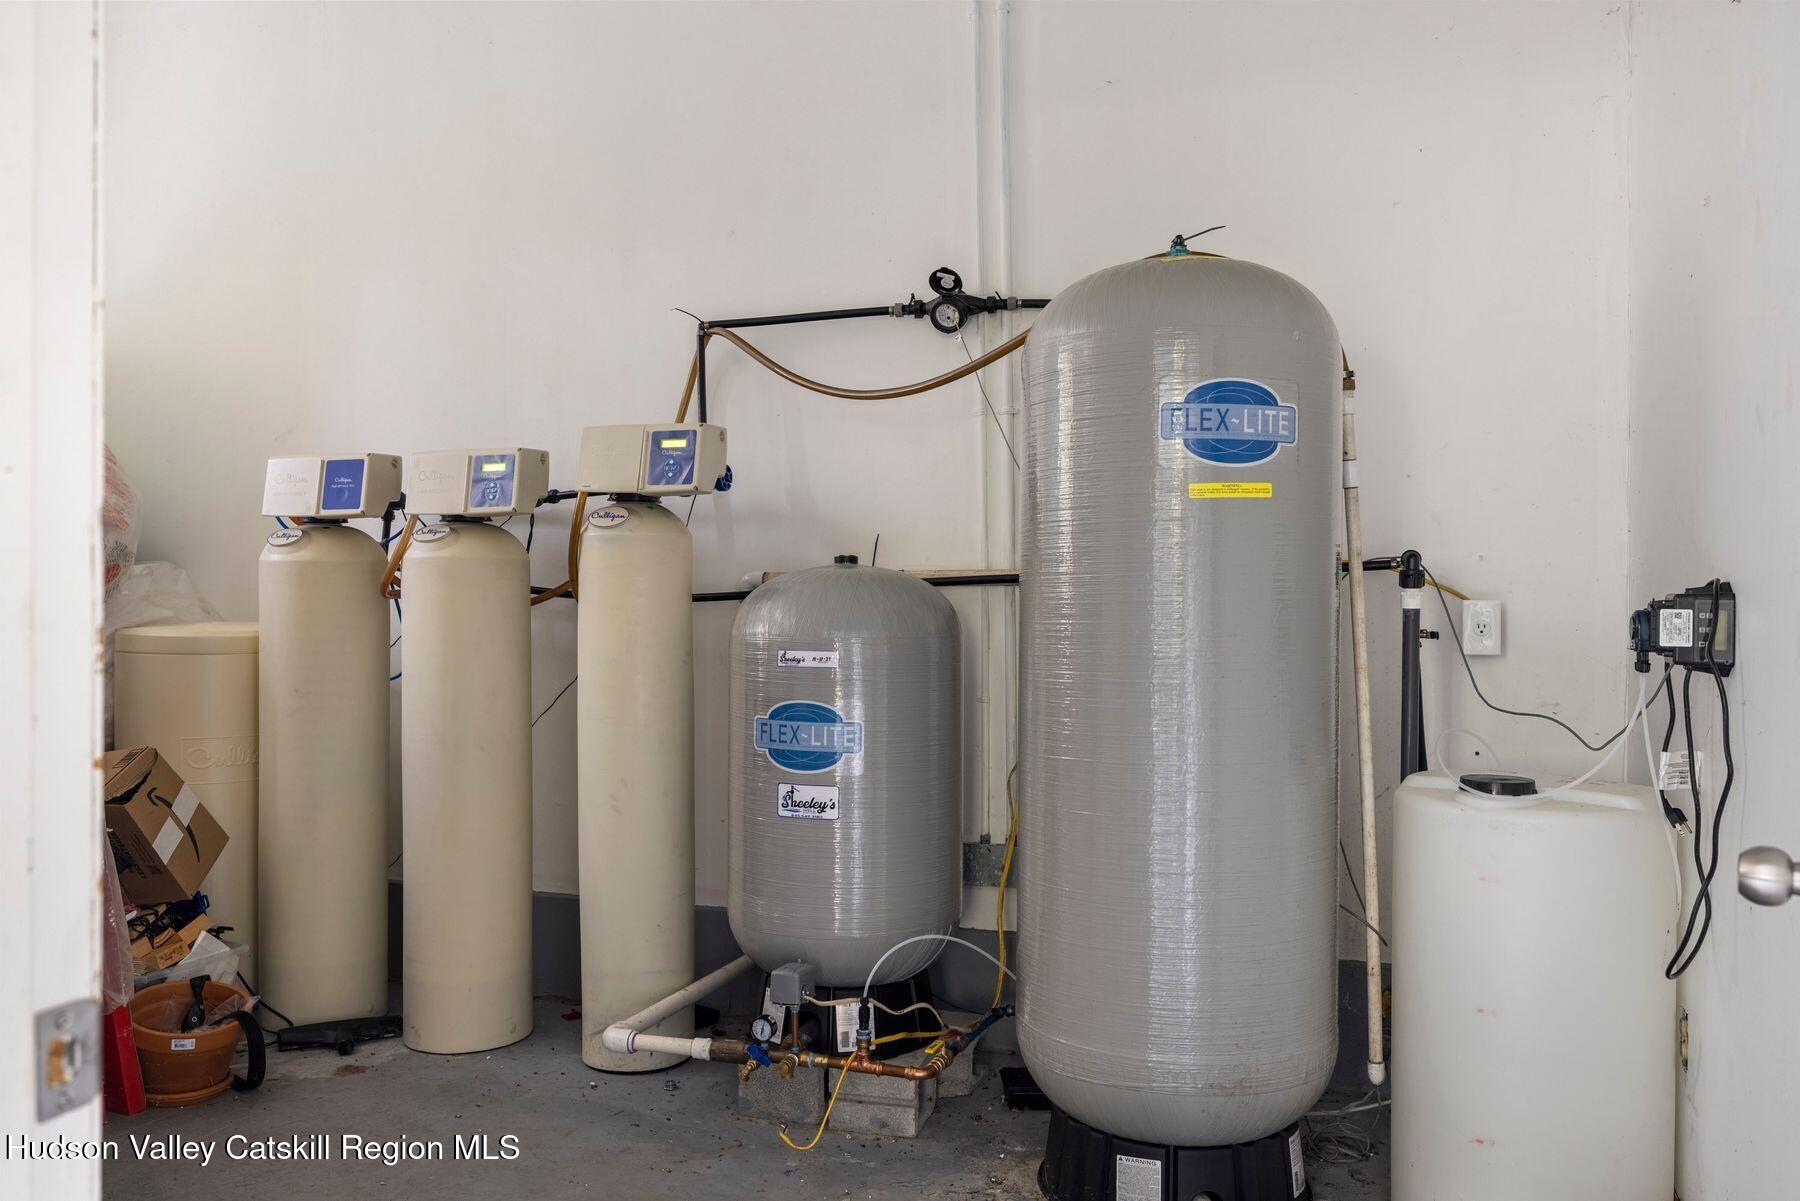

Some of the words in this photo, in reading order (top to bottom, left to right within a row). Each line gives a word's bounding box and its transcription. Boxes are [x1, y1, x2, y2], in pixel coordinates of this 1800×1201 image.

[590, 511, 626, 522] Culligan
[270, 530, 299, 541] Culligan
[415, 527, 447, 538] Culligan
[781, 792, 836, 814] Sheeley's
[1125, 1157, 1157, 1166] WARNING
